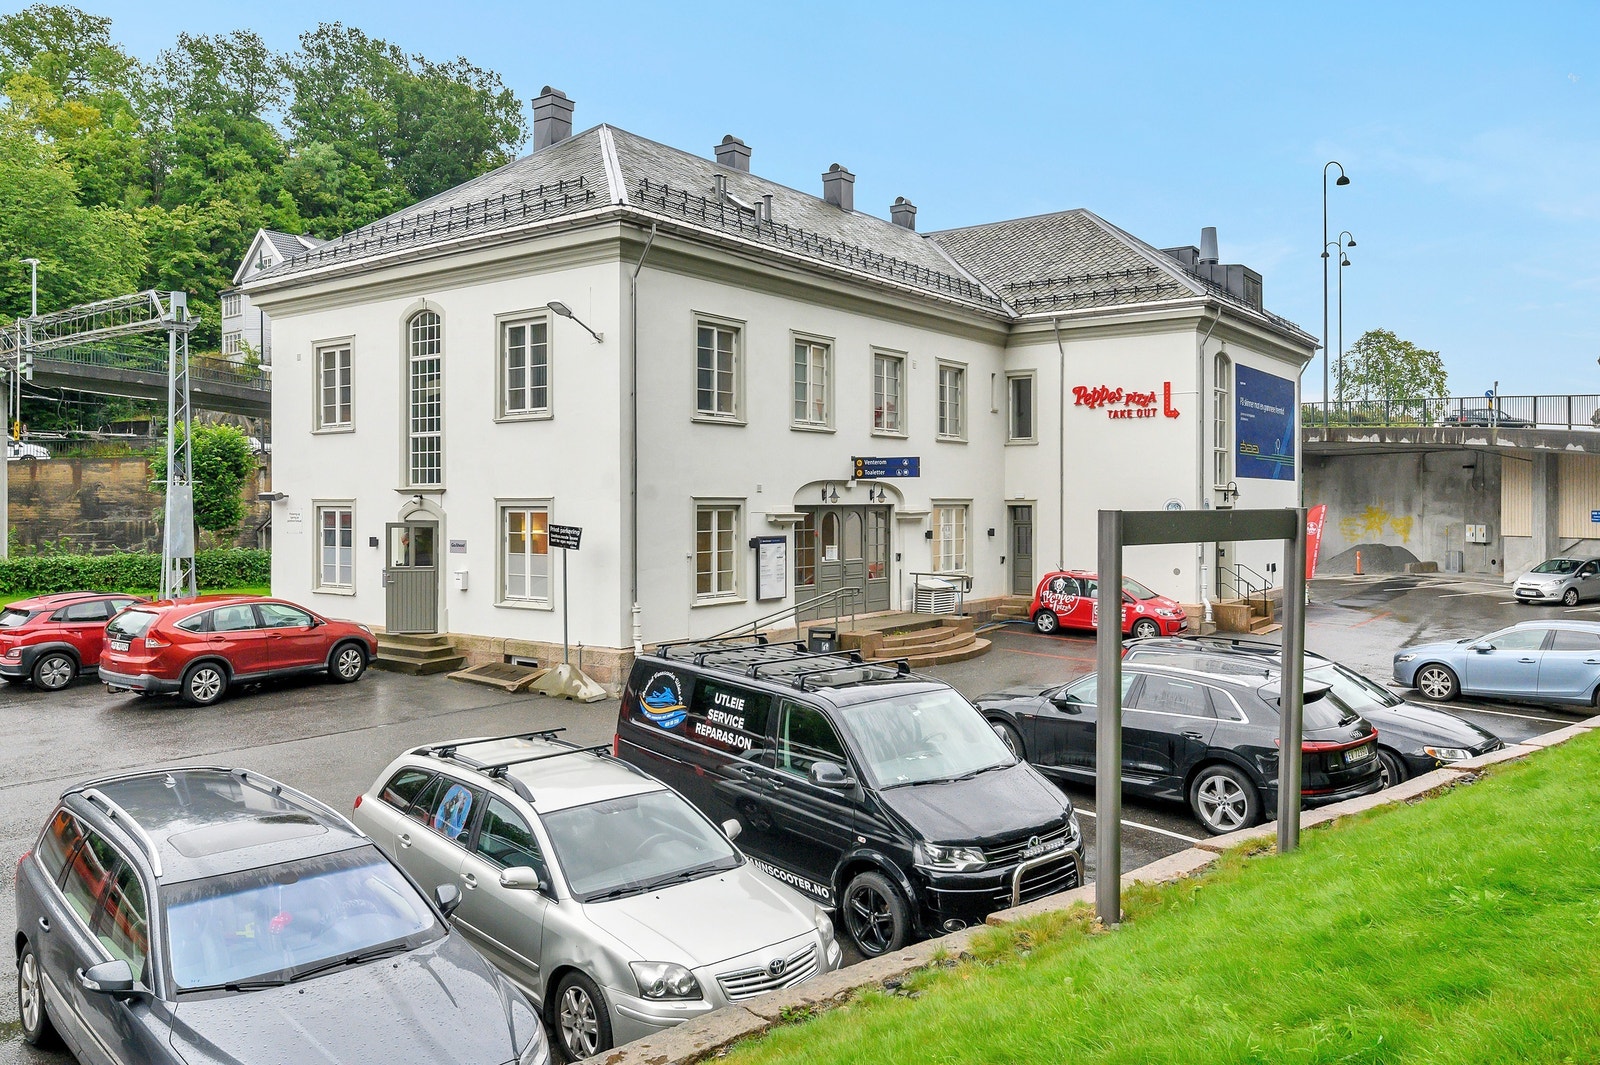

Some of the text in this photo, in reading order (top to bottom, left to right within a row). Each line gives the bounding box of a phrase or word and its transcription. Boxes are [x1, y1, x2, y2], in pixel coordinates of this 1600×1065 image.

[1072, 385, 1123, 409] Peppes
[1107, 408, 1158, 419] TAKE OUT
[714, 692, 745, 710] UTLEIE
[707, 709, 745, 729] SERVICE
[695, 722, 752, 750] REPARASJON
[747, 856, 830, 899] ANNSCOOTER.NO
